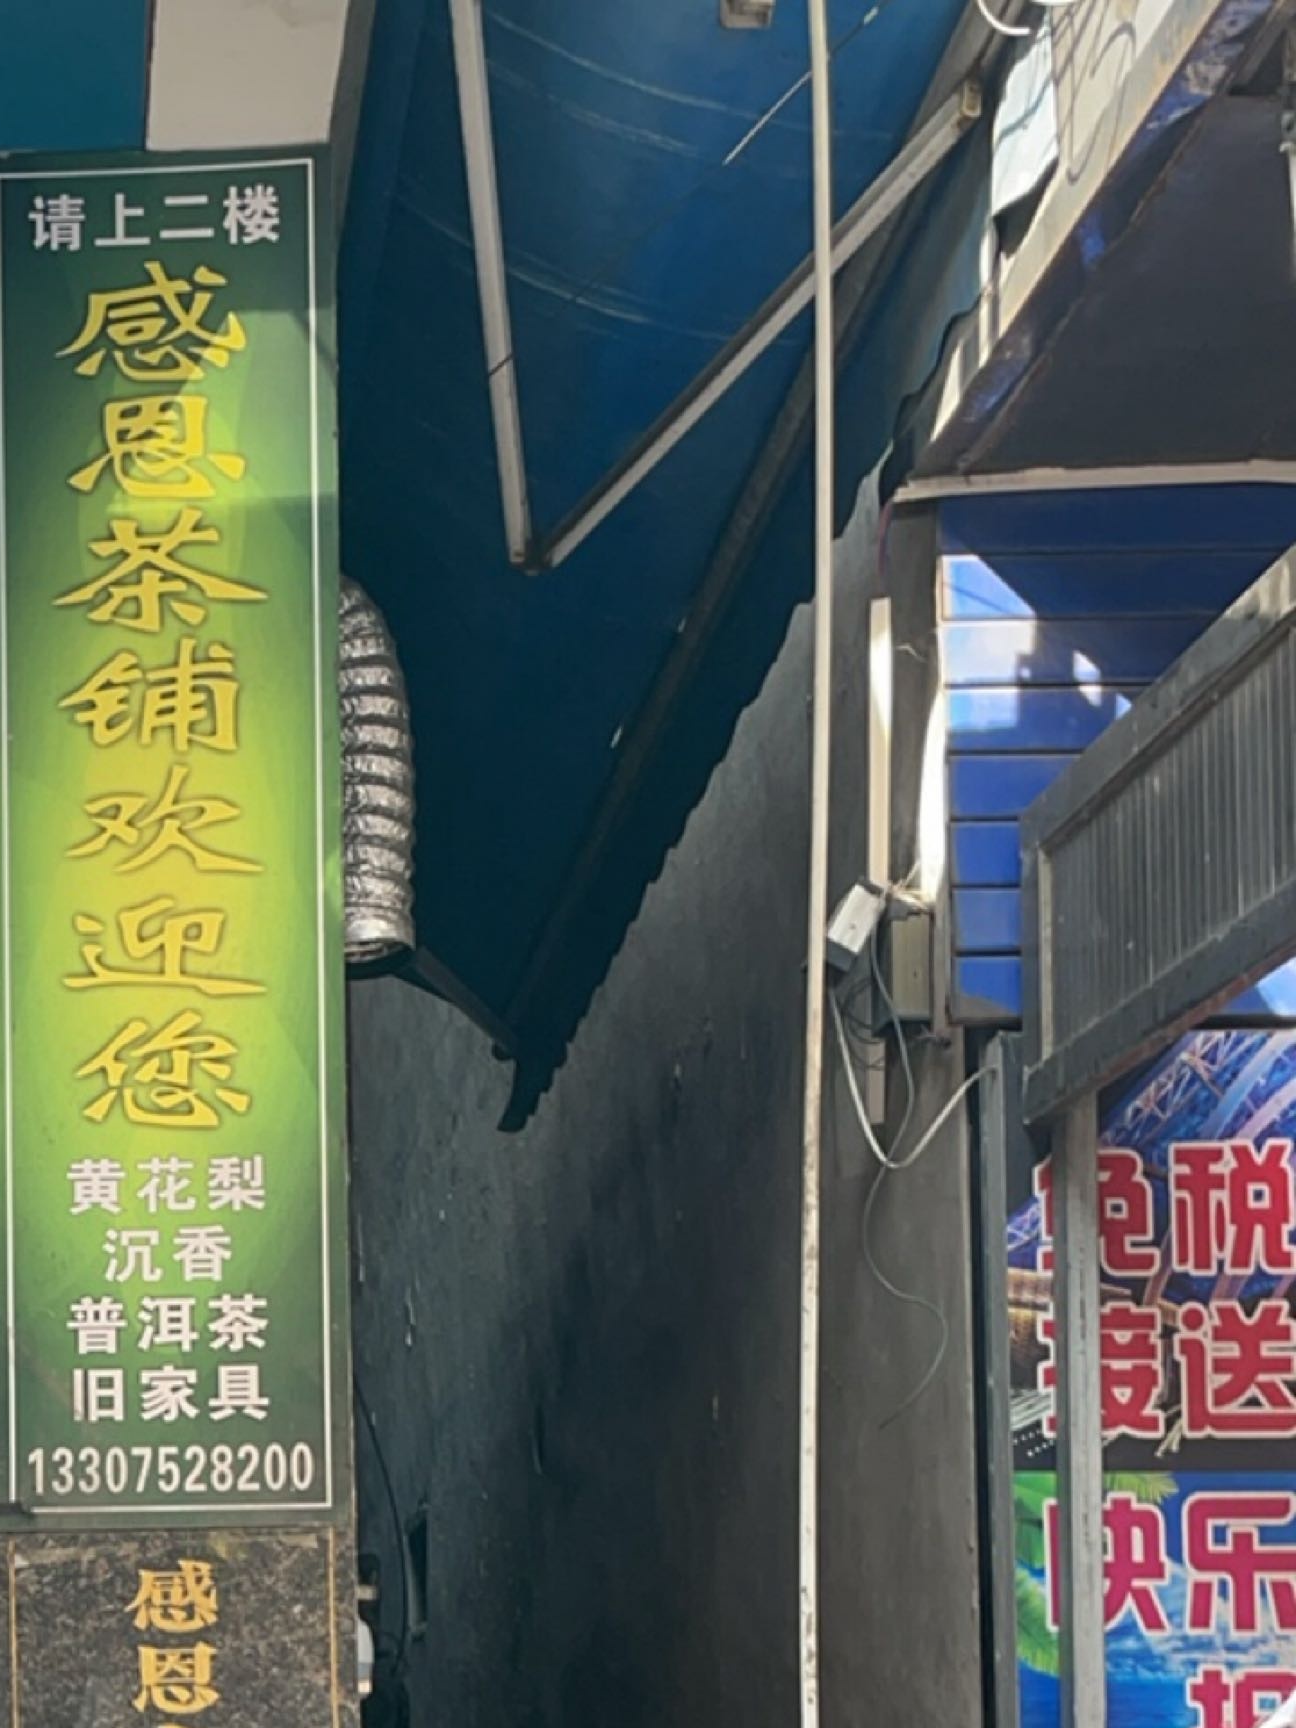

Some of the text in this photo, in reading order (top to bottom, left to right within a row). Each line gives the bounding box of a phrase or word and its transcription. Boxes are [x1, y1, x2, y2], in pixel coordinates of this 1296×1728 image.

[27, 184, 281, 252] 请上二楼
[52, 259, 269, 1128] 感恩茶铺欢迎您
[66, 1154, 267, 1215] 黄花梨
[102, 1224, 233, 1283] 沉香
[66, 1293, 269, 1355] 普洱茶
[71, 1362, 271, 1423] 旧家具
[27, 1441, 314, 1496] 13307528200
